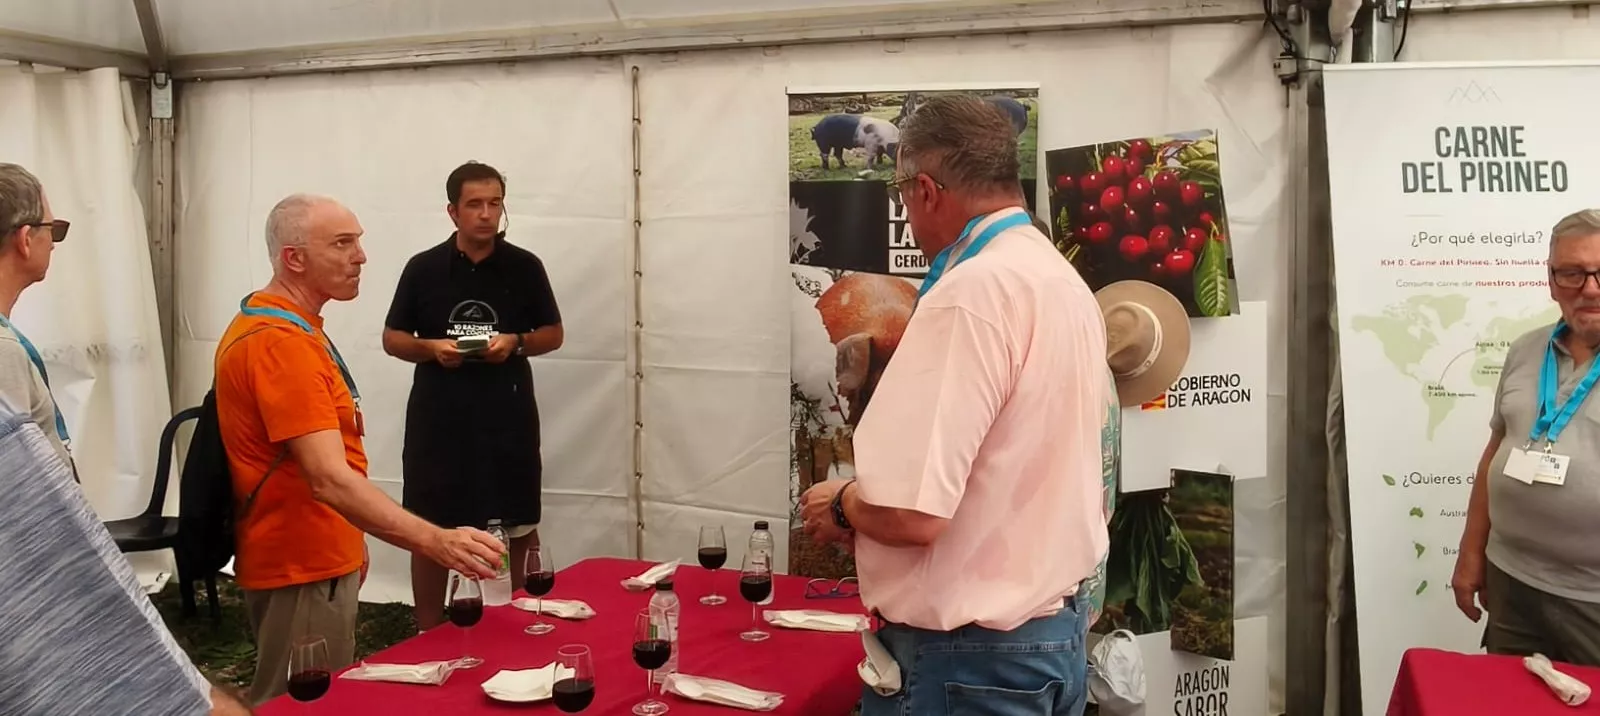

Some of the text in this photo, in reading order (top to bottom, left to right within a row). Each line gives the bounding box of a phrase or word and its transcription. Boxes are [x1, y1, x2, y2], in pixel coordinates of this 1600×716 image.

[1435, 126, 1526, 158] CARNE
[1402, 161, 1568, 193] DEL PIRINEO
[889, 223, 916, 247] LA
[1411, 231, 1543, 247] ¿Por qué elegirla?
[895, 254, 930, 268] CERD
[1168, 389, 1251, 408] DE ARAGON
[1402, 472, 1461, 487] ¿Quieres
[1174, 661, 1229, 698] ARAGÓN
